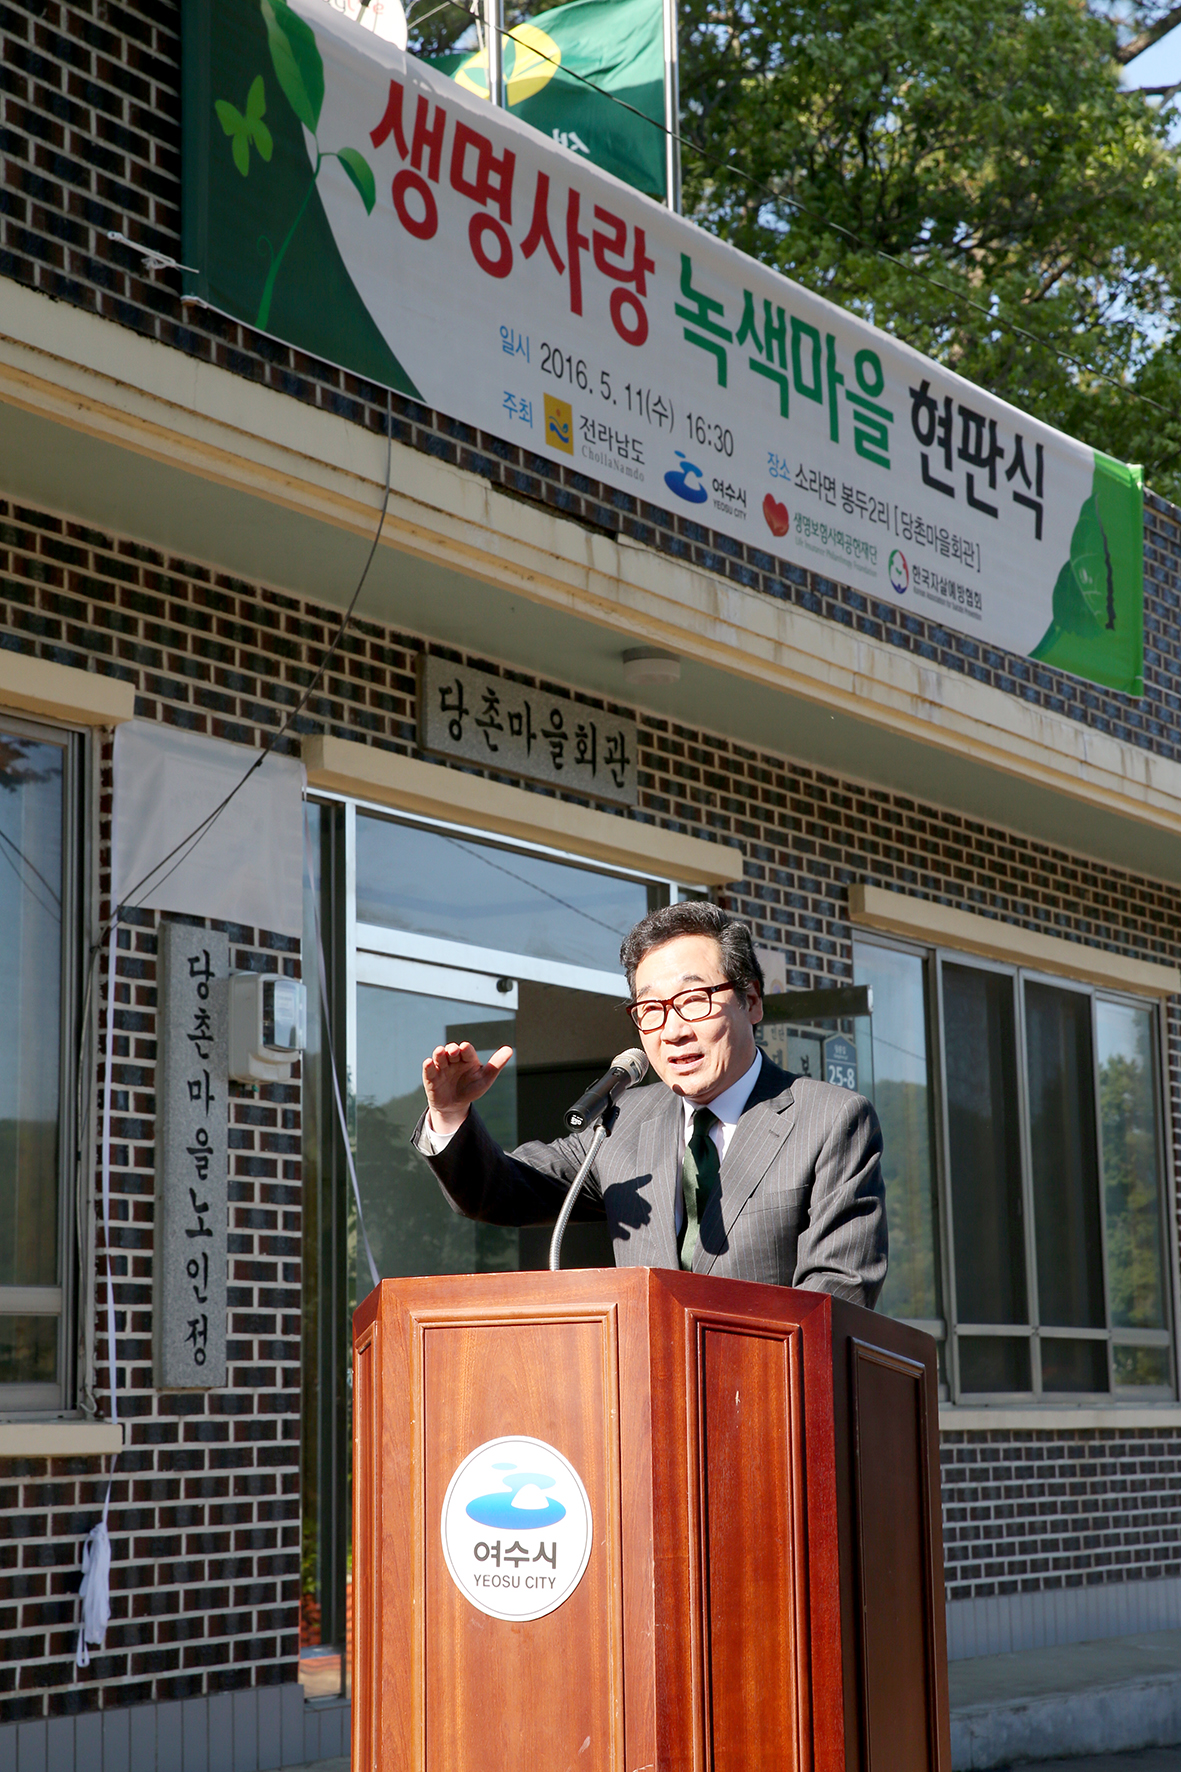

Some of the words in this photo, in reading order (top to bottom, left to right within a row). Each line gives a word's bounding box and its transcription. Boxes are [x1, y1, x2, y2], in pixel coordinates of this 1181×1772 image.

[369, 78, 656, 347] 생명사랑
[674, 252, 894, 470] 녹색마을
[908, 379, 1044, 541] 현판식
[499, 325, 530, 363] 일시
[686, 412, 734, 457] 16:30
[767, 451, 791, 482] 장소
[794, 463, 837, 506] 소라면
[841, 482, 890, 531] 봉두2리
[502, 391, 533, 428] 주최
[579, 415, 645, 465] 전라남도
[581, 444, 645, 482] ChollaNamdo
[712, 478, 747, 508] 여수시
[713, 499, 733, 515] YEOSU
[734, 507, 747, 520] CITY
[793, 512, 878, 566] 생명보험사회공헌재단
[912, 564, 982, 611] 한국자살예방협회
[438, 678, 630, 788] 당촌마을회관
[828, 1065, 855, 1090] 25-8
[185, 949, 215, 1367] 당촌마을노인정
[473, 1540, 557, 1569] 여수시
[473, 1574, 521, 1588] YEOSU
[525, 1576, 557, 1590] CITY
